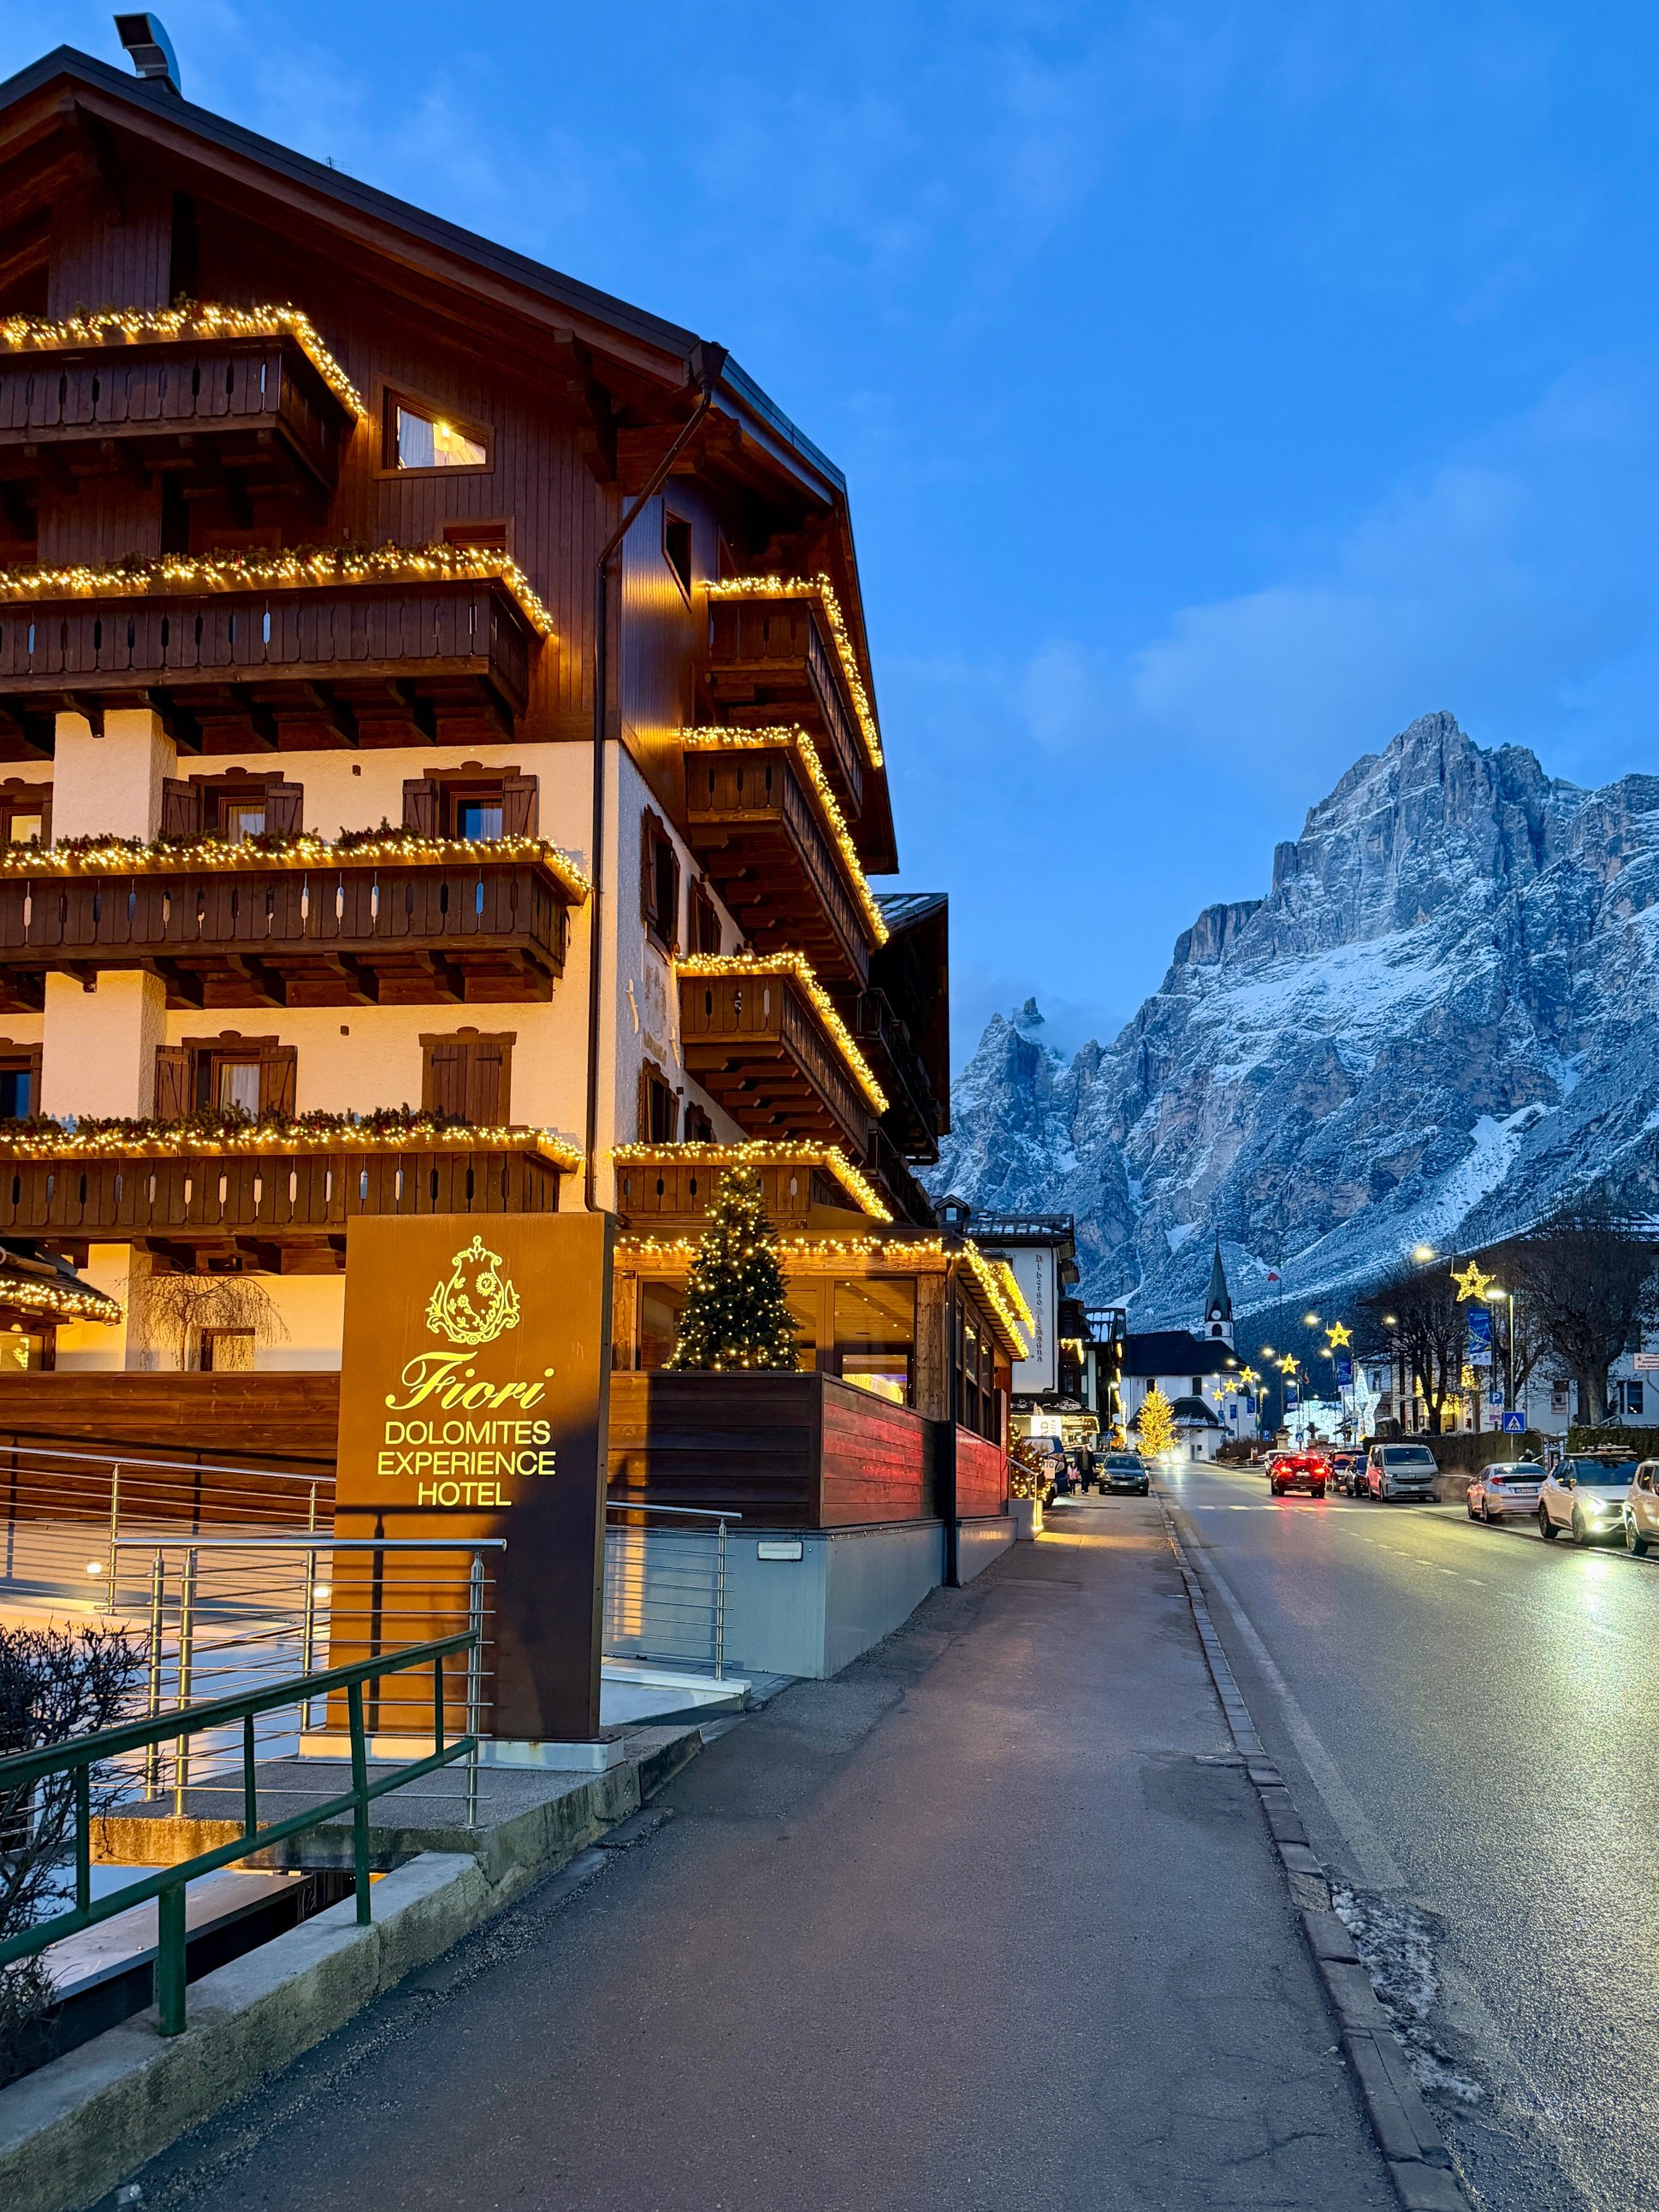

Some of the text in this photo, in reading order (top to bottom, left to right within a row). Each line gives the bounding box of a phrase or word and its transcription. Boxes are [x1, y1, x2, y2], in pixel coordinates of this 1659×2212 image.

[385, 1351, 554, 1411] Fiori
[1492, 1394, 1500, 1403] P
[385, 1420, 551, 1445] DOLOMITES
[377, 1451, 557, 1476] EXPERIENCE
[418, 1482, 512, 1506] HOTEL
